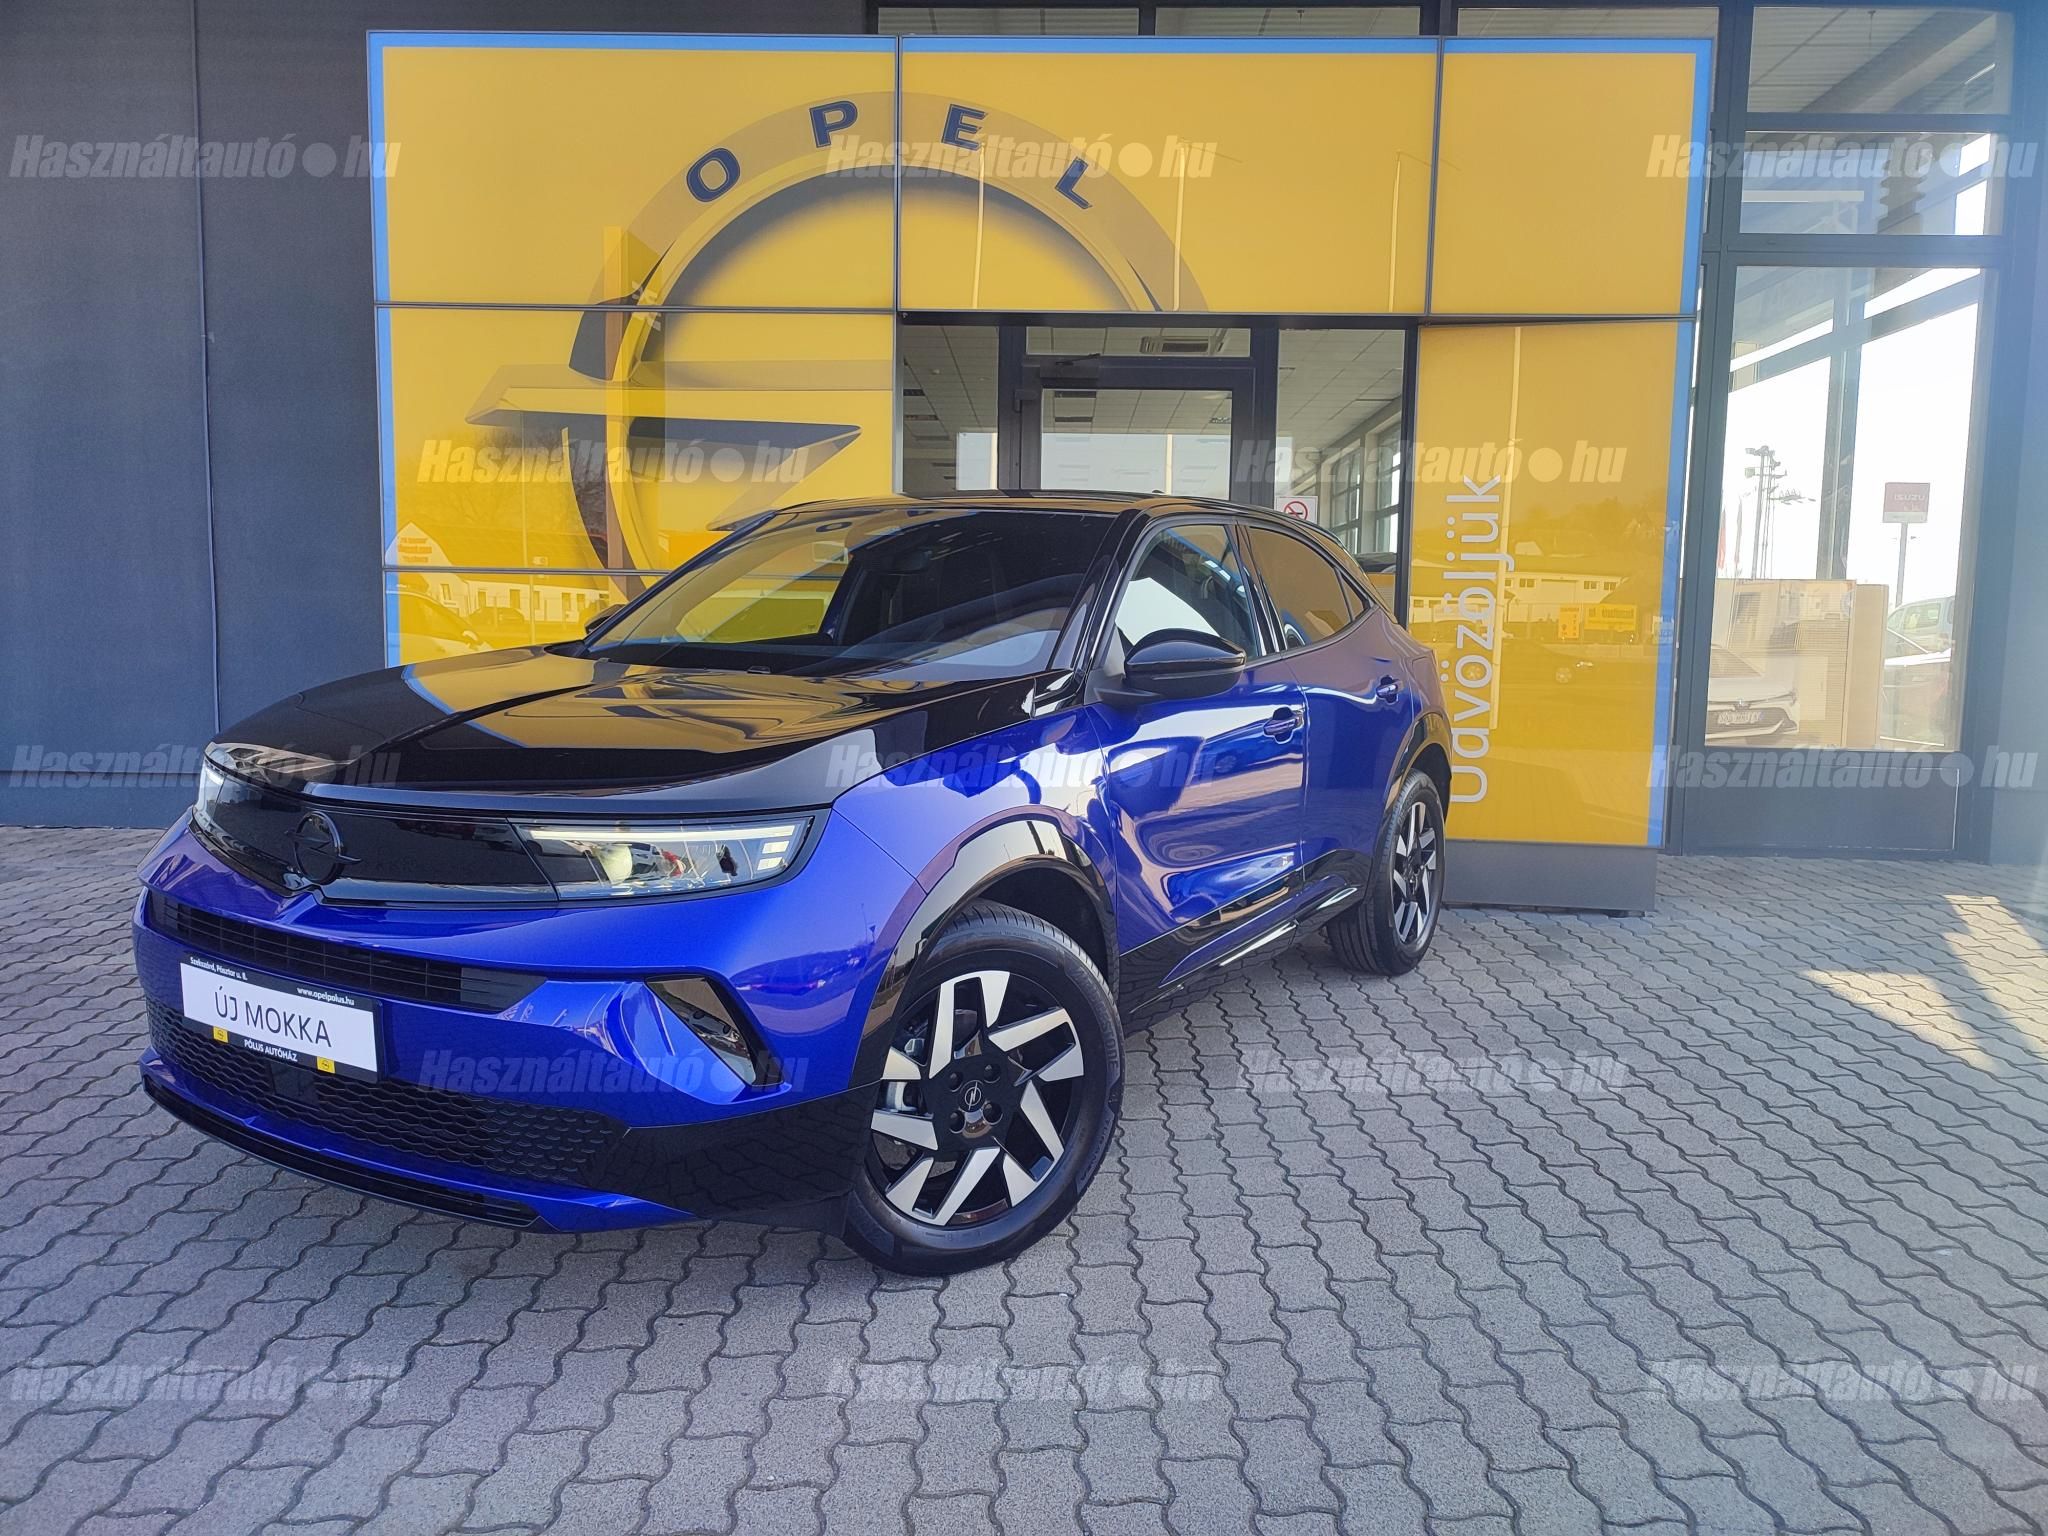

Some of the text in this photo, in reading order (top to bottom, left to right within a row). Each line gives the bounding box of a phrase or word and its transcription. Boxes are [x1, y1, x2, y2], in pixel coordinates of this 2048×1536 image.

[685, 100, 1093, 210] OPEL
[214, 985, 332, 1048] ÚJ MOKKA
[296, 987, 355, 1006] www.opelpolus.hu
[244, 1038, 298, 1062] PÓLUS AUTÓHÁZ
